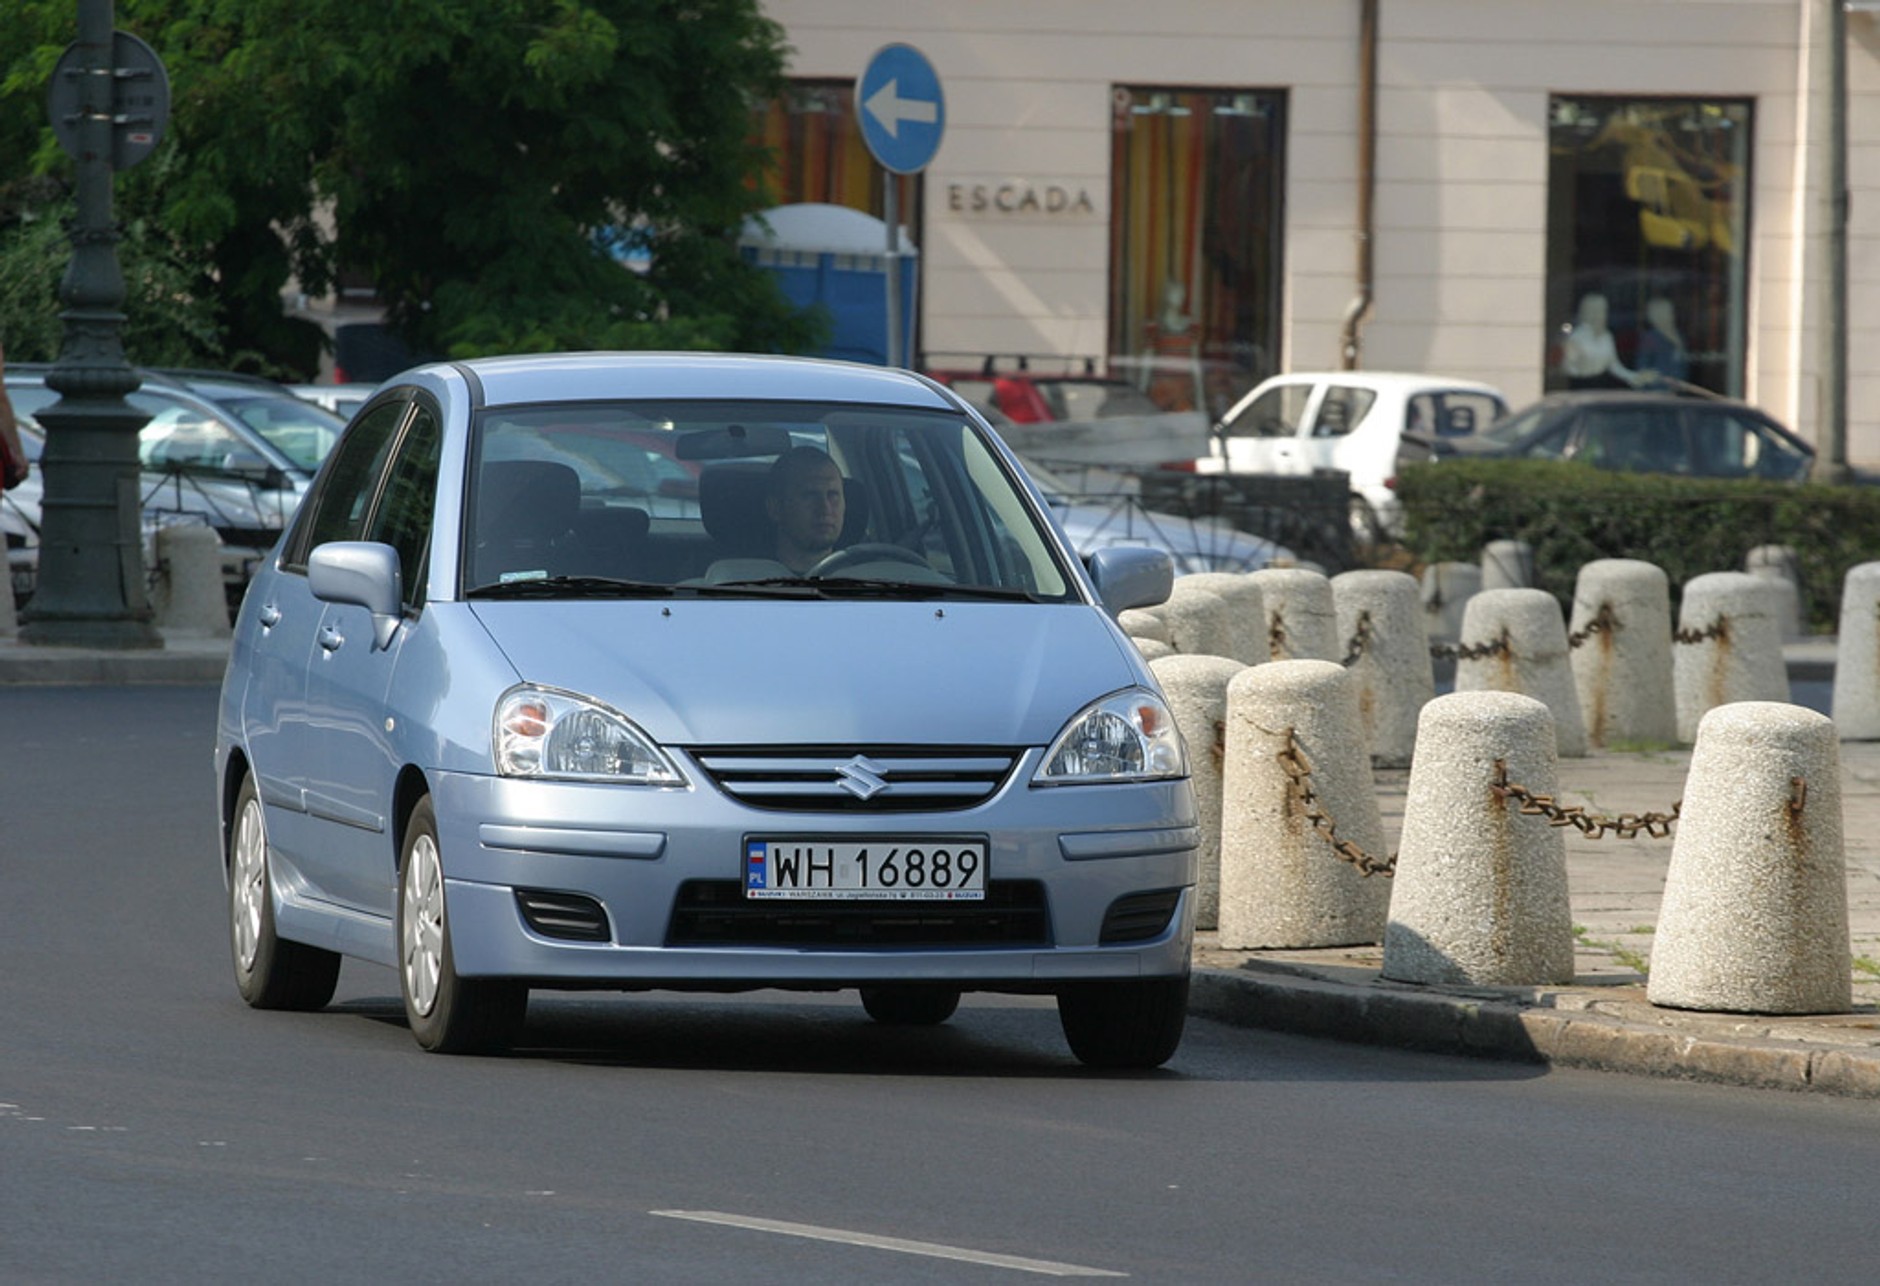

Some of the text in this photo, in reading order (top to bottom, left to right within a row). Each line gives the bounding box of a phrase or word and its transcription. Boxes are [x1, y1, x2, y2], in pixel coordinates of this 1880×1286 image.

[947, 184, 1093, 213] ESCADA
[749, 872, 764, 884] PL
[774, 848, 979, 888] WH 16889
